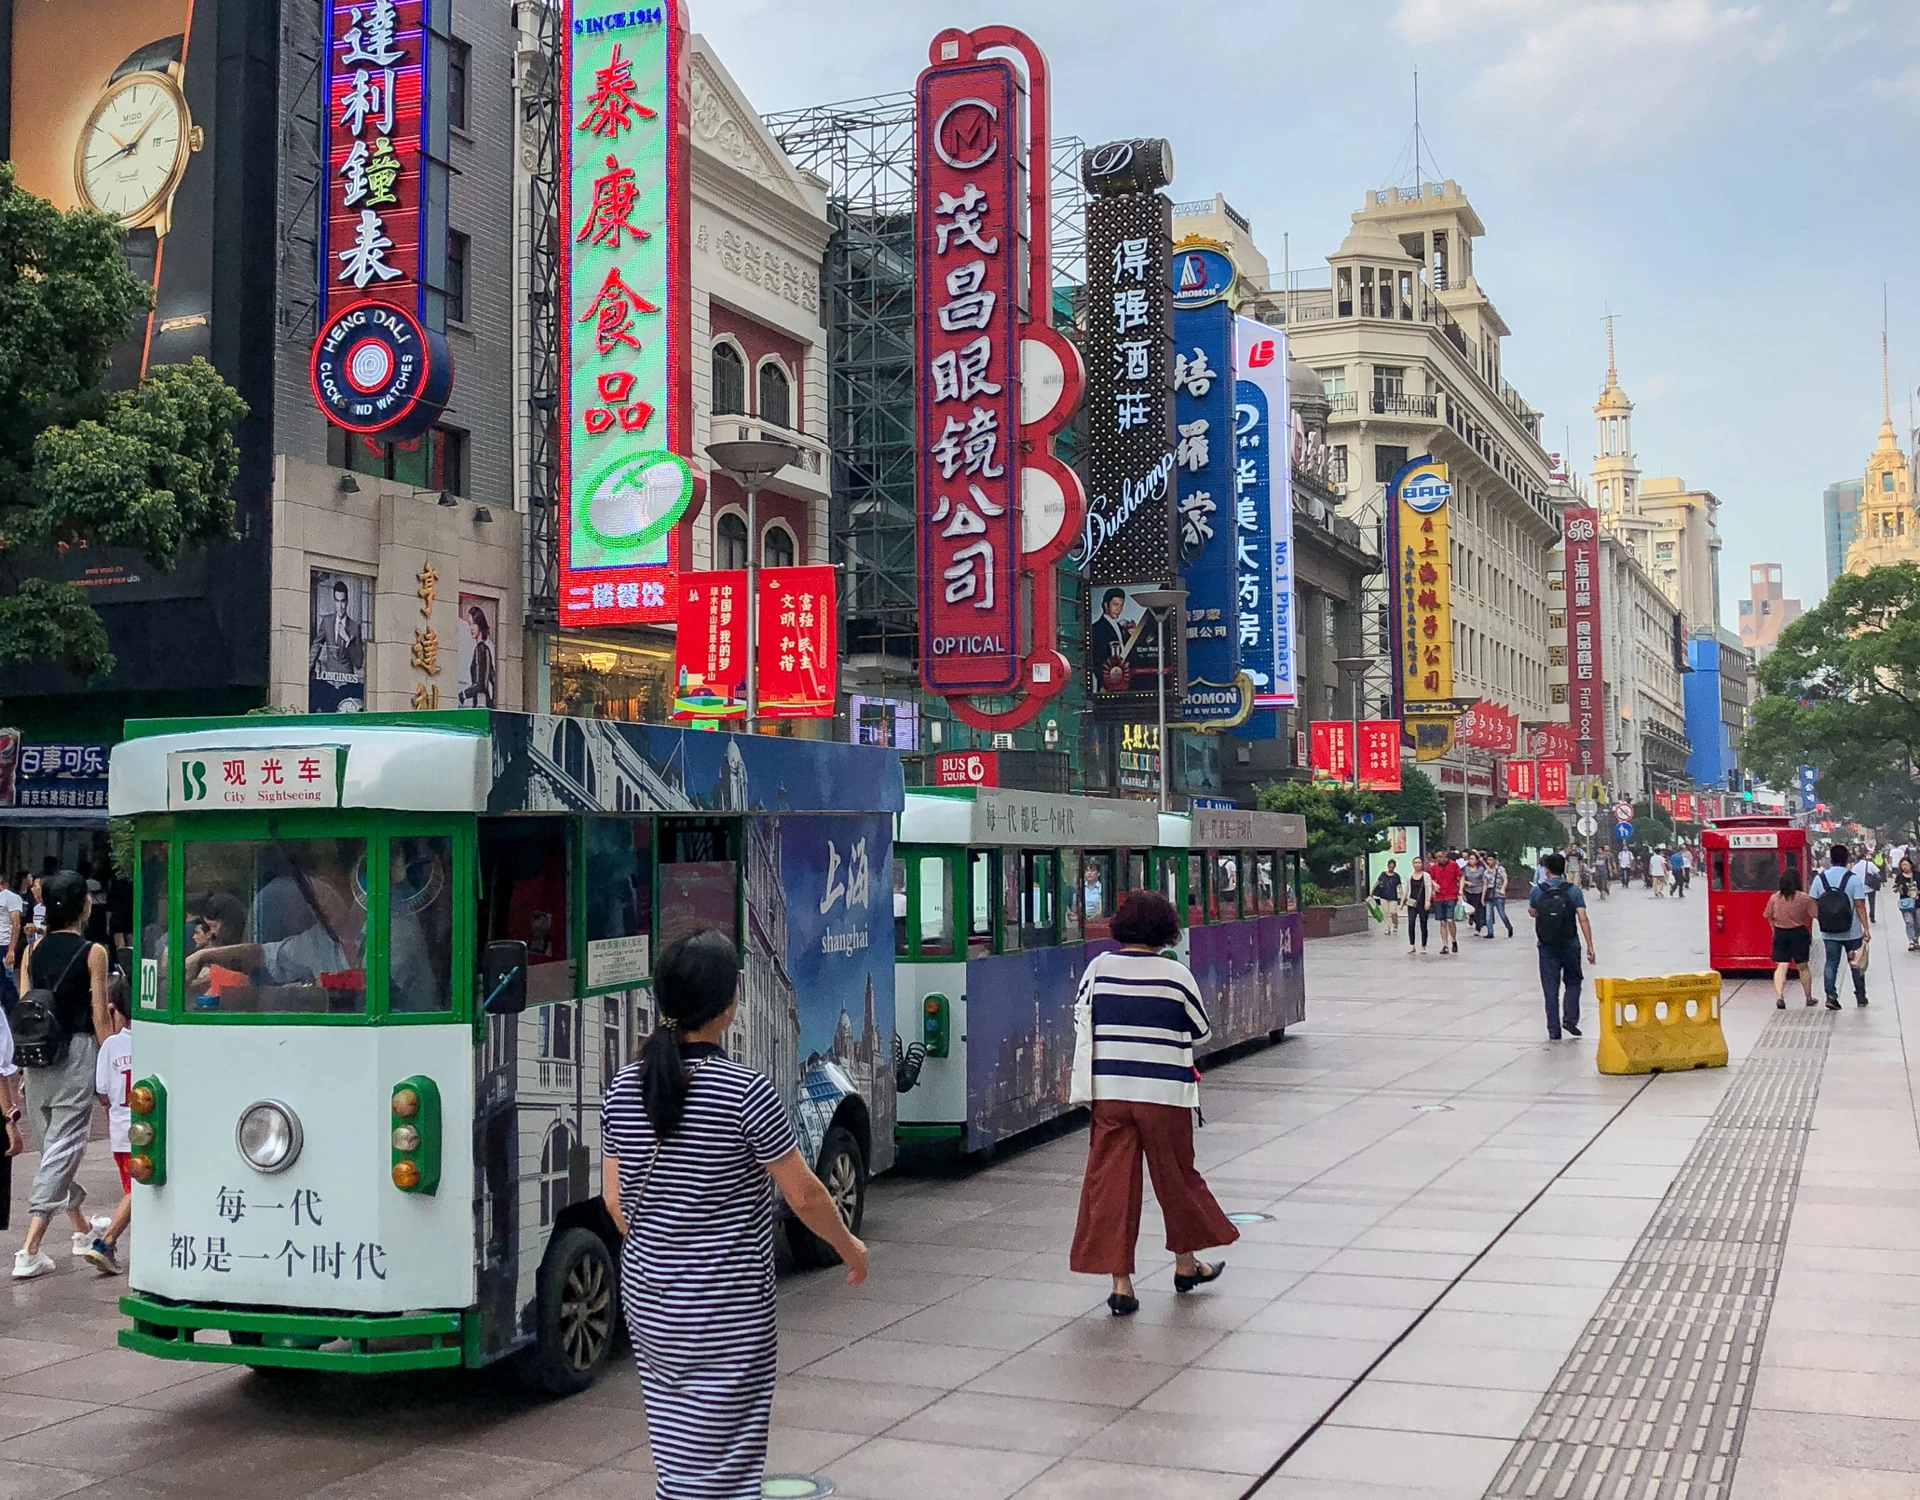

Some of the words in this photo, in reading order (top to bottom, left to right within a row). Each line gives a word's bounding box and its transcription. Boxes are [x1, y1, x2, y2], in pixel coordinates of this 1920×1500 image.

[575, 43, 661, 434] 泰康食品
[323, 311, 366, 353] HENG
[373, 309, 411, 344] DALI
[376, 354, 413, 410] WATCHES
[931, 183, 1005, 609] 茂昌眼镜公司
[1402, 484, 1451, 499] BAC
[1069, 448, 1178, 571] Duchamp
[1274, 540, 1288, 584] No.1
[567, 582, 666, 610] 二楼餐饮
[720, 585, 733, 627] 中国梦
[780, 594, 795, 627] 文明
[799, 593, 814, 628] 富强
[1574, 548, 1593, 680] 上海市第一食品商店
[718, 630, 731, 671] 我的梦
[779, 636, 796, 672] 和谐
[798, 637, 814, 670] 民主
[932, 634, 1006, 656] OPTICAL
[1275, 591, 1289, 683] Pharmacy
[315, 670, 359, 684] LONGINES
[1180, 692, 1237, 704] ROMON
[1580, 687, 1592, 710] First
[21, 745, 104, 774] 百事可乐
[222, 757, 322, 786] 观光车
[942, 757, 966, 771] BUS
[942, 772, 967, 782] TOUR
[224, 789, 245, 803] City
[258, 788, 322, 803] Sightseeing
[986, 802, 1017, 833] 每一代
[1021, 804, 1075, 835] 都是一个时代
[820, 836, 869, 915] 上海
[821, 922, 869, 957] shanghai
[142, 965, 155, 1002] 10
[215, 1185, 324, 1227] 每一代
[168, 1232, 388, 1281] 都是一个时代
